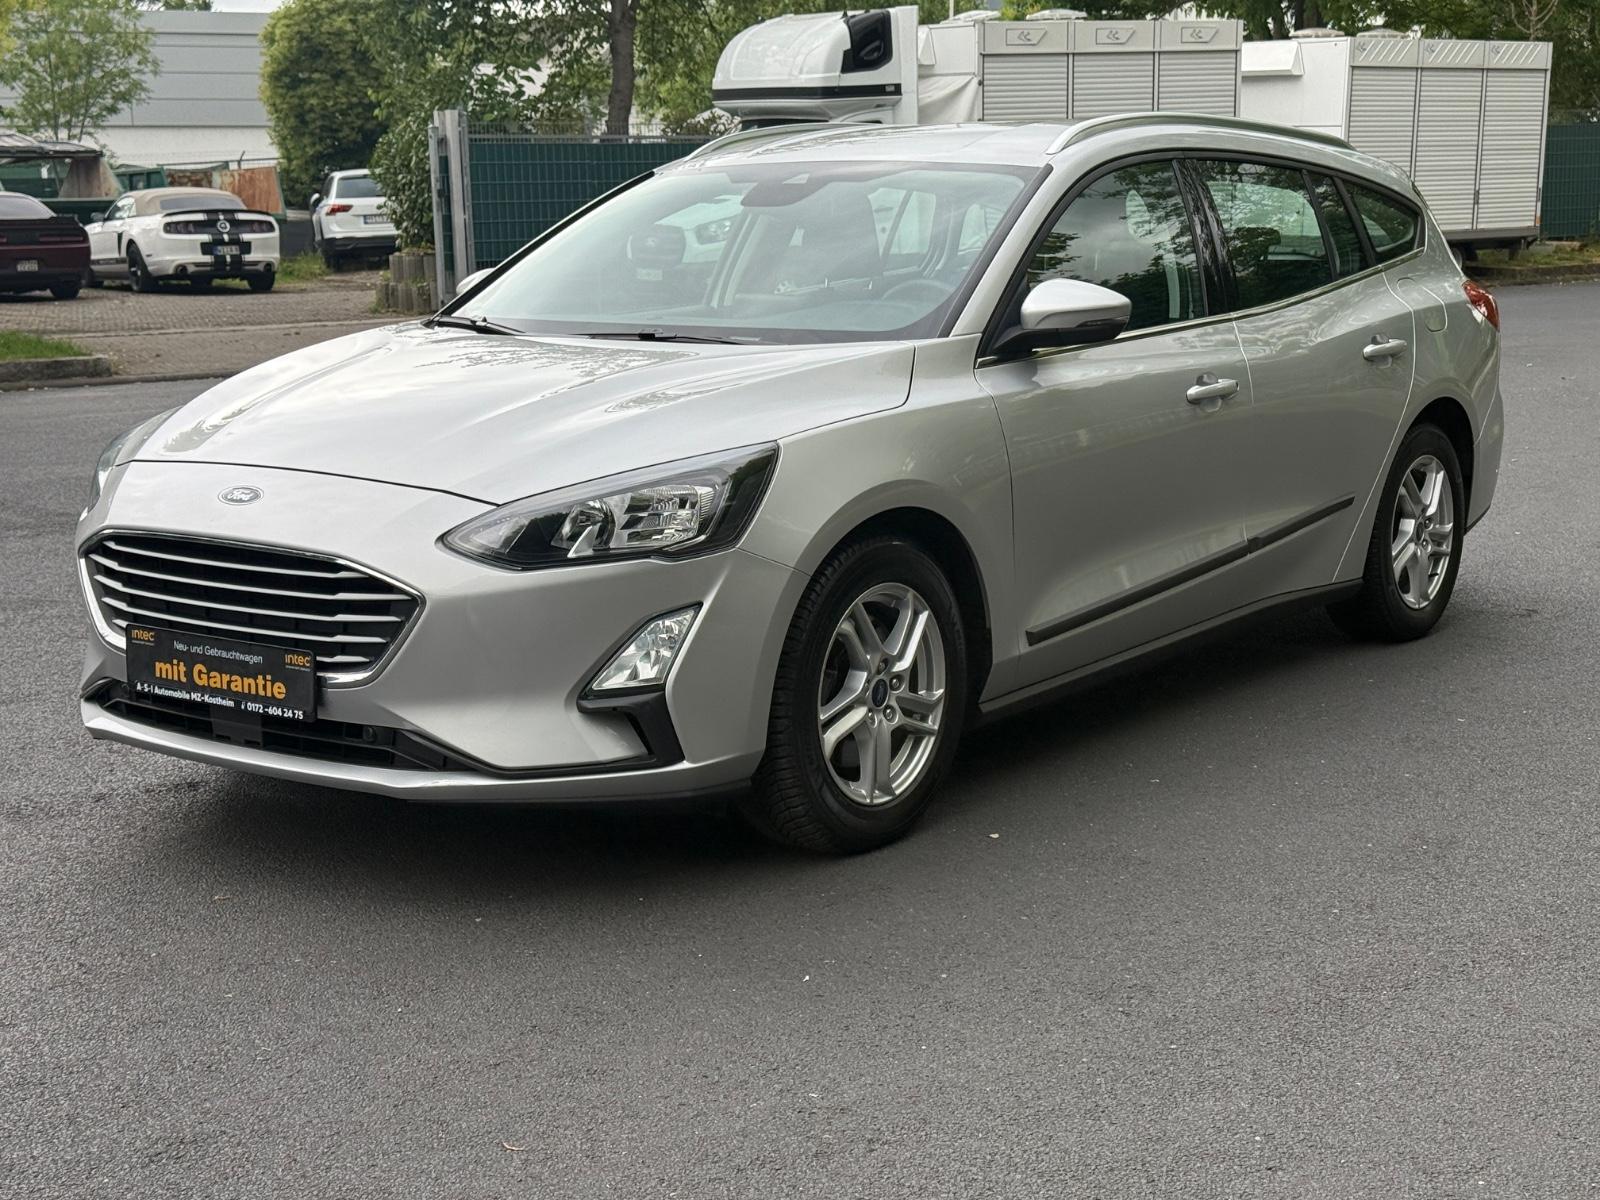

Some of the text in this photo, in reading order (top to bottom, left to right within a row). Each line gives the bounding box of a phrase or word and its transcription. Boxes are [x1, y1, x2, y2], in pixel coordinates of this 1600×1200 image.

[131, 629, 155, 642] intec
[173, 640, 263, 664] Neu- und Gebrauchtwagen
[285, 653, 311, 667] intec
[154, 659, 287, 700] mit Garantie
[154, 686, 190, 699] Automobile
[191, 692, 235, 707] MZ-Kostheim
